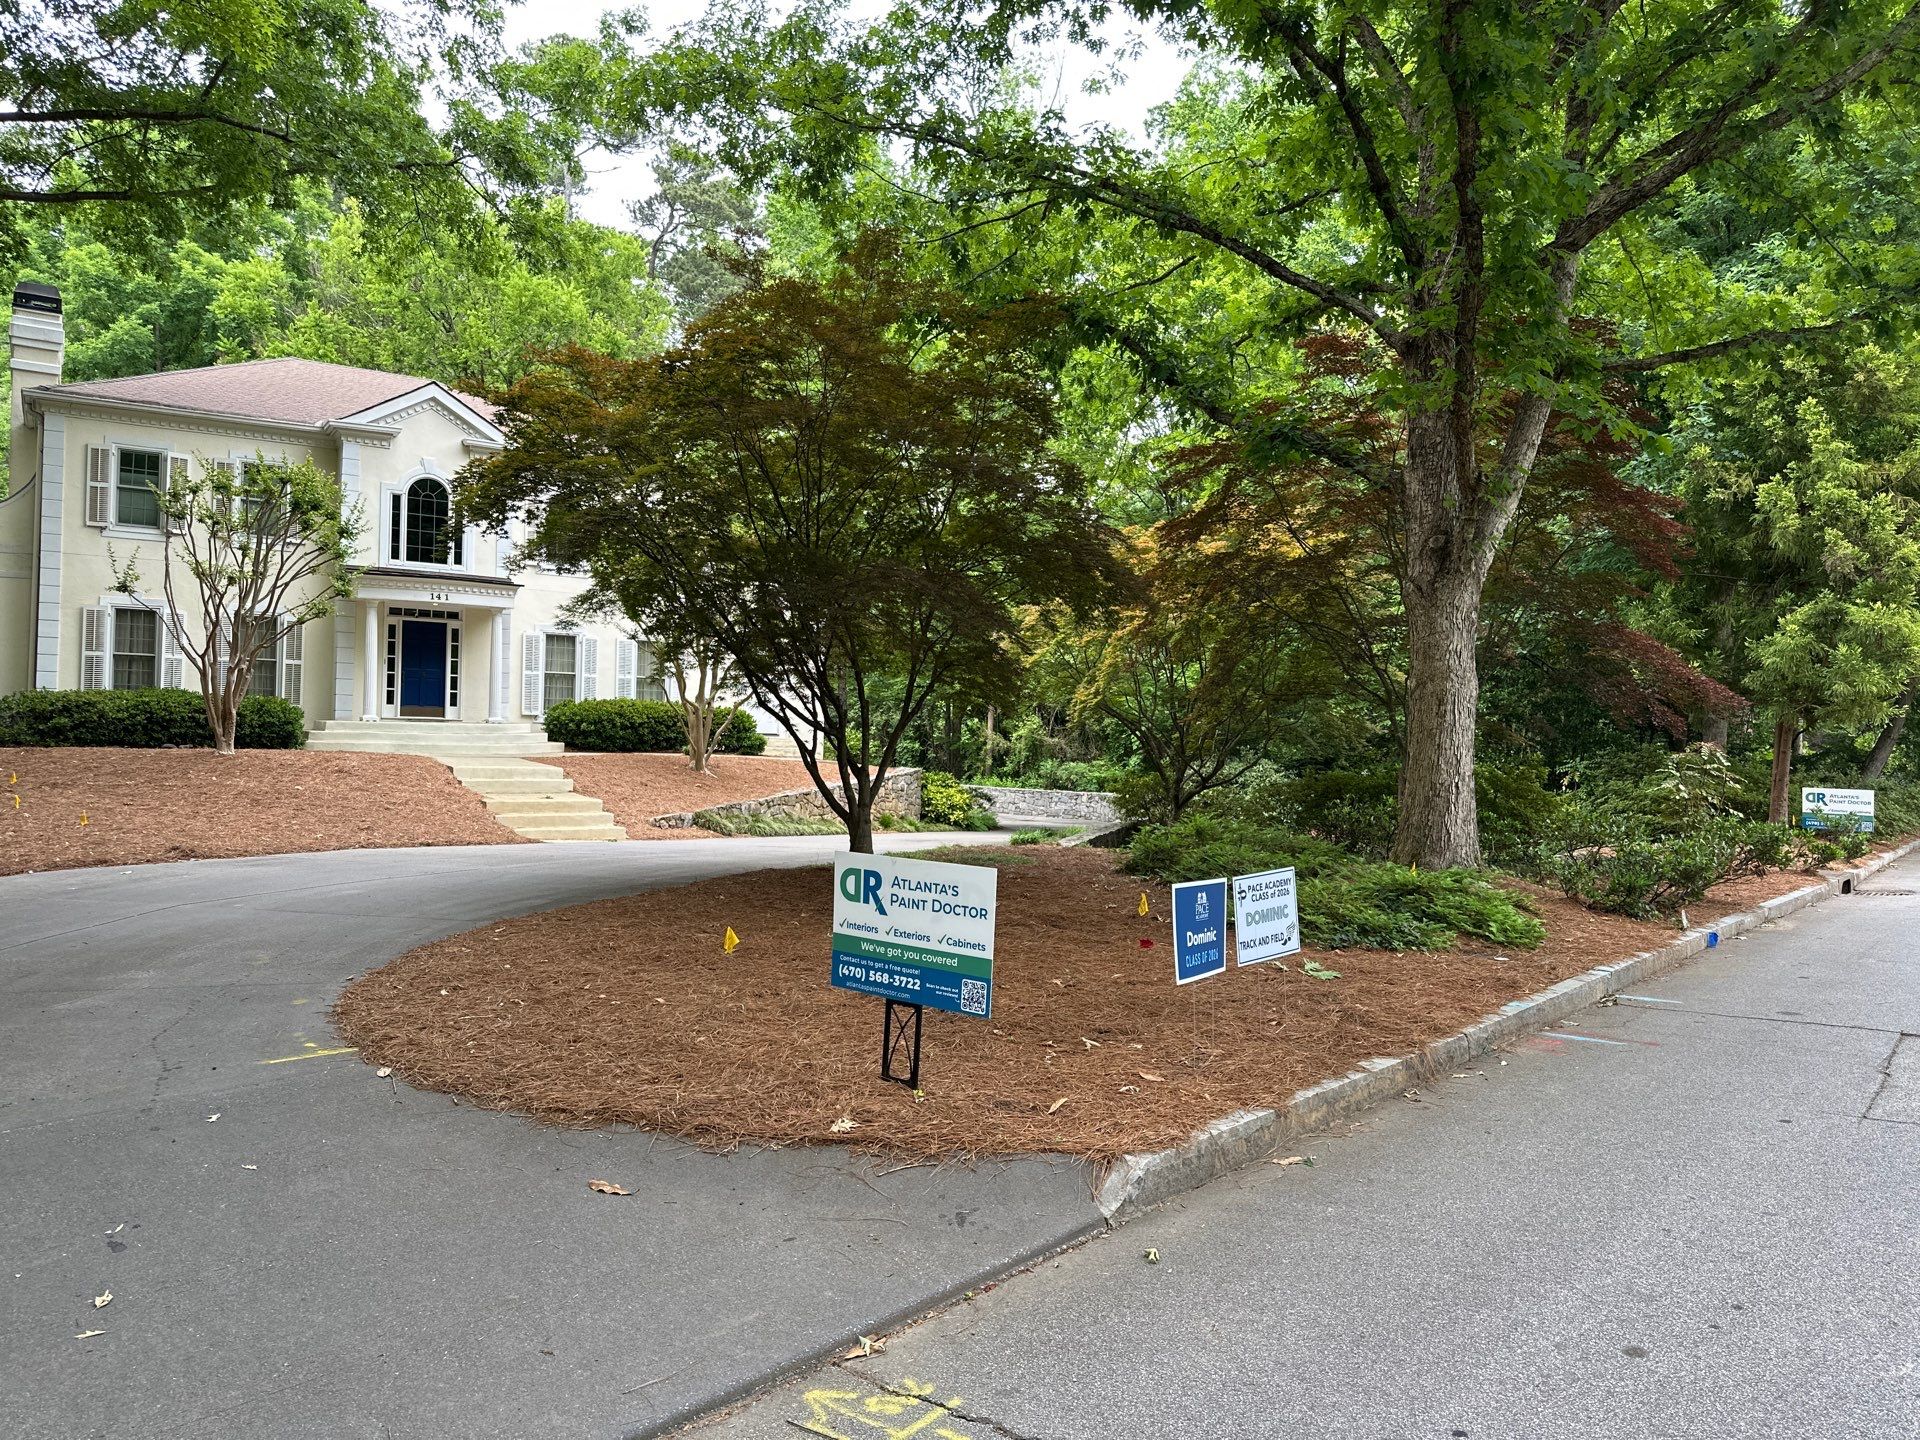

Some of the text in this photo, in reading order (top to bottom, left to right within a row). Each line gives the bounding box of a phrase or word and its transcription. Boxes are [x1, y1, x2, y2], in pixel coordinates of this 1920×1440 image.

[891, 876, 959, 897] ATLANTA'S
[1248, 878, 1291, 893] PACE ACADEMY
[1251, 891, 1269, 902] CLASS
[1277, 888, 1290, 897] 2026
[890, 894, 988, 920] PAINT DOCTOR
[1196, 903, 1209, 914] PACE
[1246, 904, 1289, 926] DOMINIC
[846, 921, 986, 951] Interiors Exteriors Cabinets
[1186, 926, 1217, 947] Dominic
[1240, 932, 1284, 950] TRACK AND FIELD
[860, 942, 958, 966] We've got you covered
[1186, 948, 1218, 968] CLASS OF 2026
[840, 954, 860, 964] Contact
[889, 962, 901, 971] free
[902, 966, 920, 976] quote!
[838, 964, 921, 990] (470) 568-3722
[846, 980, 910, 999] atlantaspaintdoctor.com
